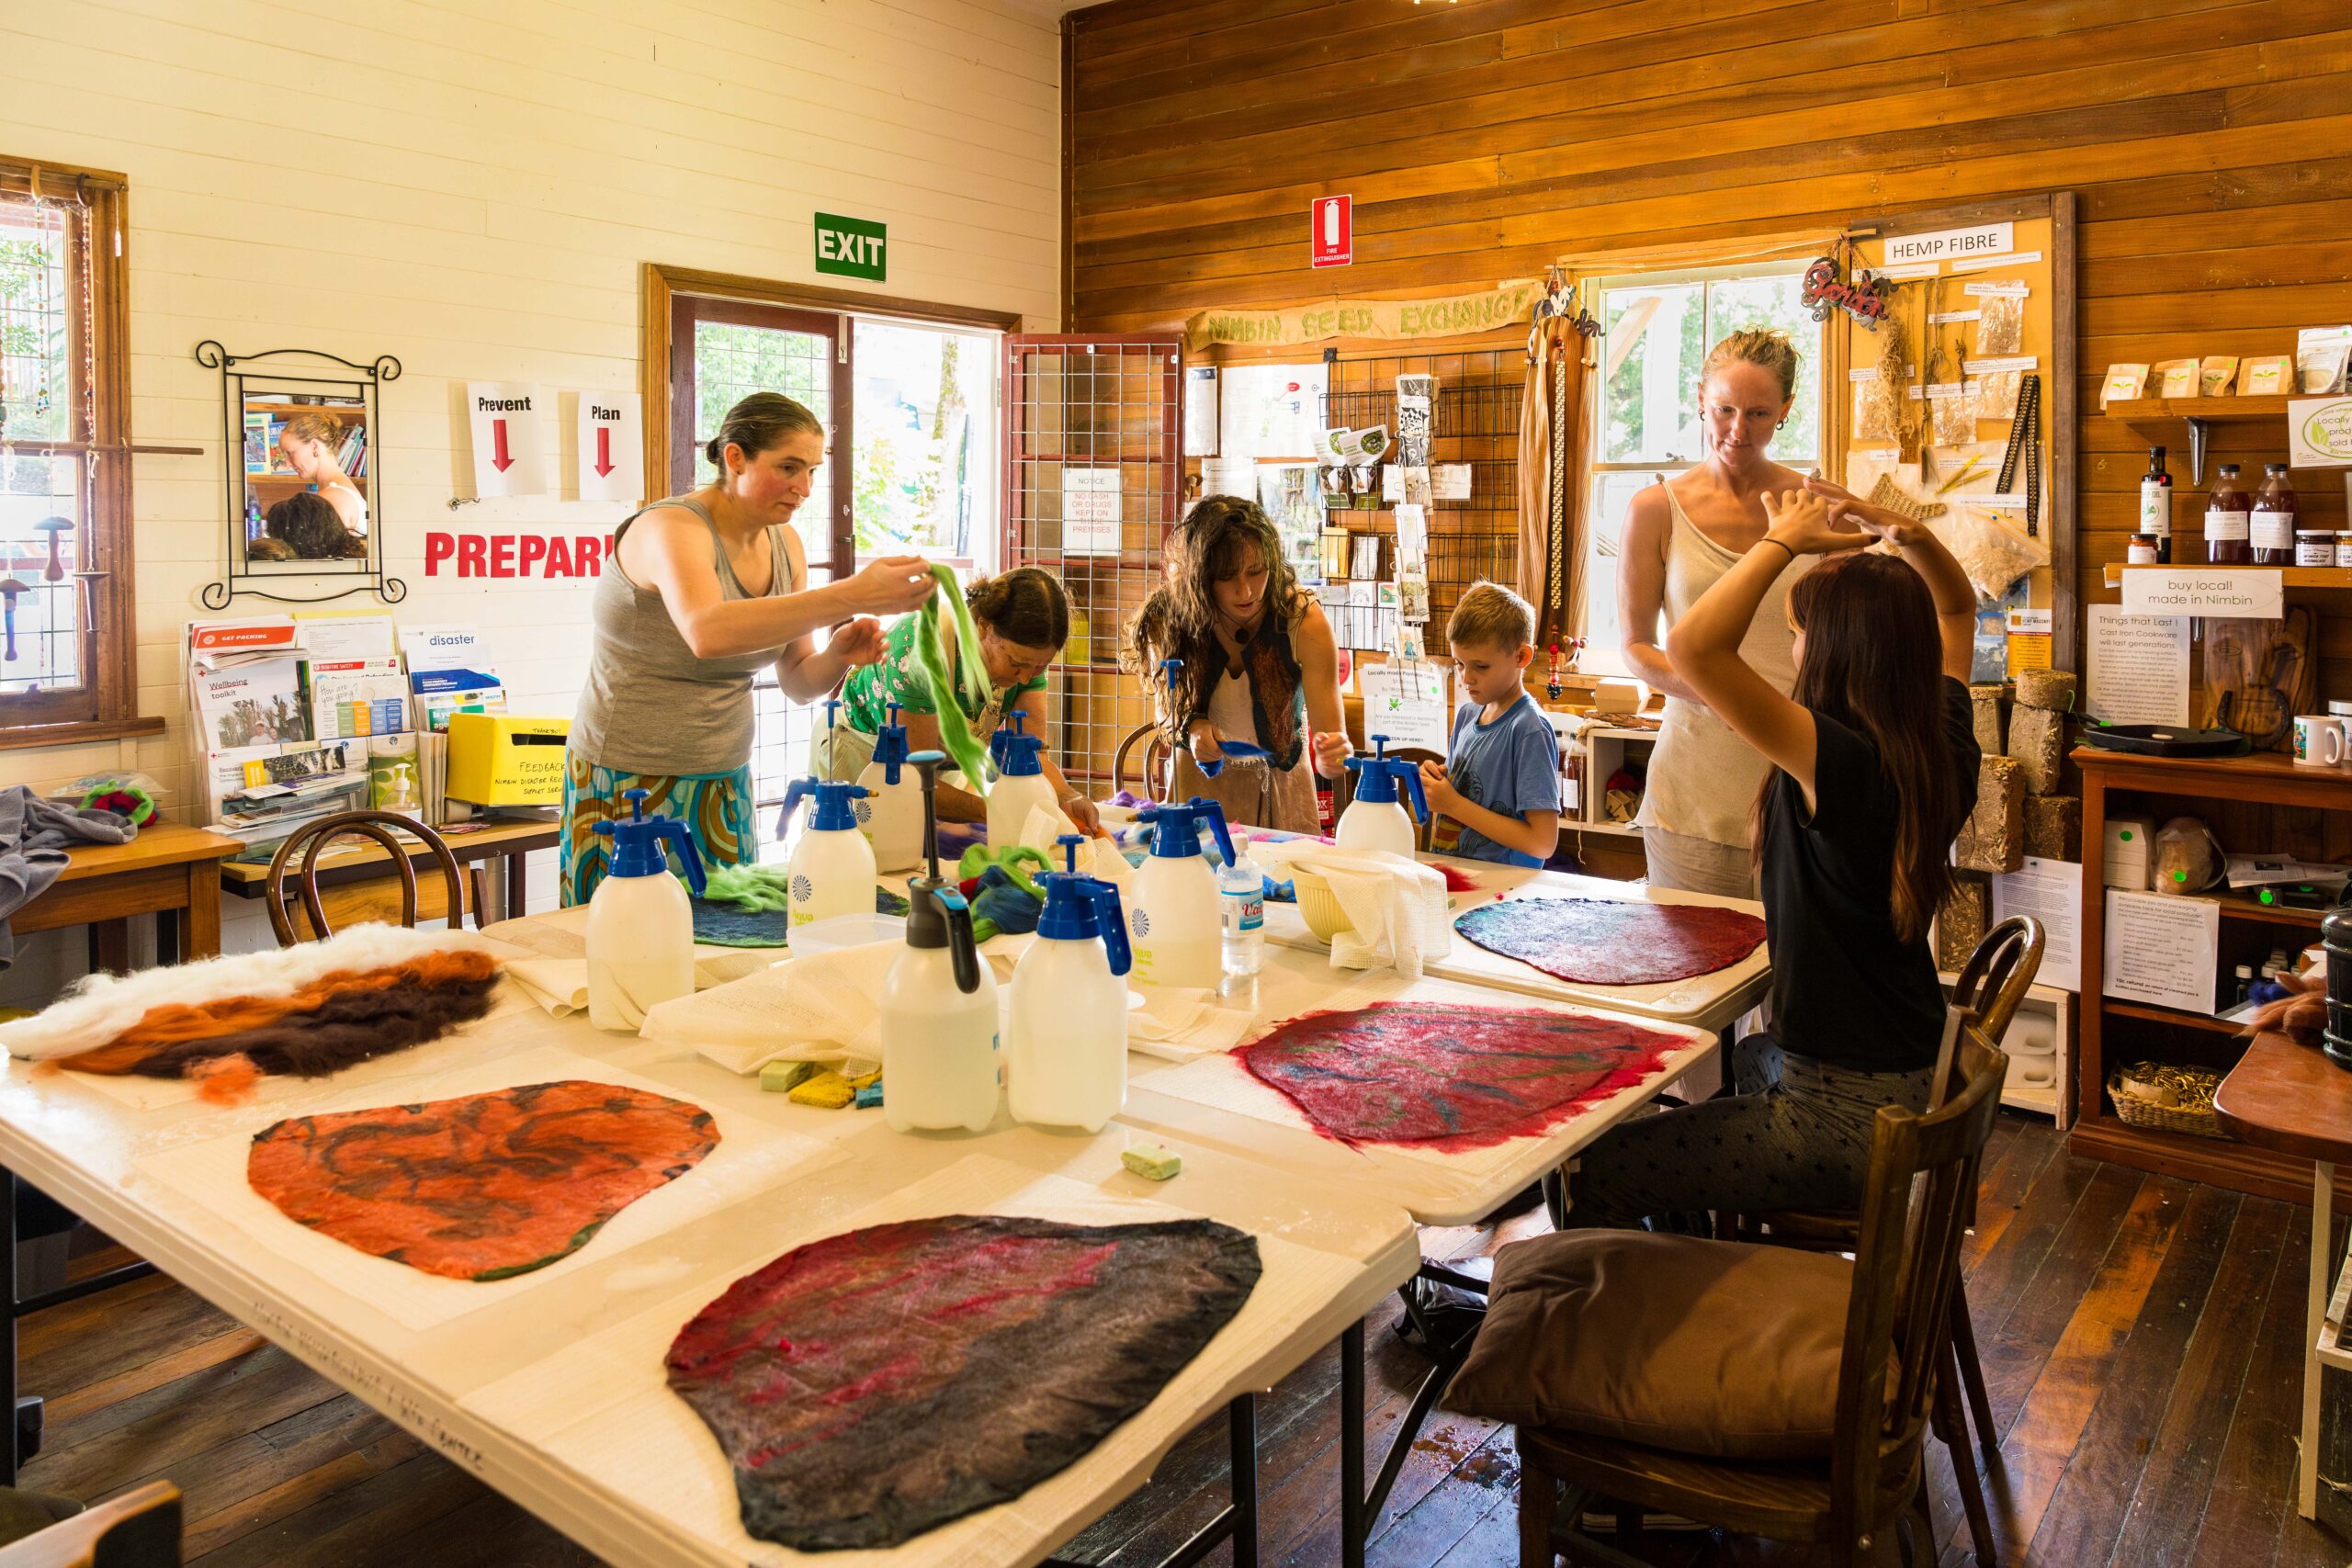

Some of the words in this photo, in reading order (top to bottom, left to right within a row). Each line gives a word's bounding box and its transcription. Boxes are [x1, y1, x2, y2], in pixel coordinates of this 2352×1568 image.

[818, 229, 884, 266] EXIT
[1894, 240, 1943, 258] HEMP
[1950, 233, 1997, 252] FIBRE
[1314, 254, 1350, 263] EXTINGUISHER
[1208, 315, 1281, 342] NIMBIN
[1302, 308, 1374, 336] SEED
[479, 397, 531, 412] Prevent
[592, 406, 620, 421] Plan
[2317, 416, 2350, 424] Locally
[2329, 439, 2347, 447] sold
[2168, 581, 2192, 592] buy
[2196, 581, 2233, 591] local!
[2148, 594, 2187, 604] made
[2191, 594, 2202, 604] in
[2206, 595, 2252, 605] Nimbin
[2099, 616, 2128, 626] Things
[2132, 617, 2150, 626] that
[430, 635, 475, 646] disaster
[2128, 640, 2177, 649] generations.
[209, 679, 248, 691] Wellbeing
[321, 685, 334, 696] How
[211, 690, 236, 700] toolkit
[322, 695, 334, 707] you
[519, 761, 565, 772] FEEDBACK
[2169, 903, 2197, 912] packaging
